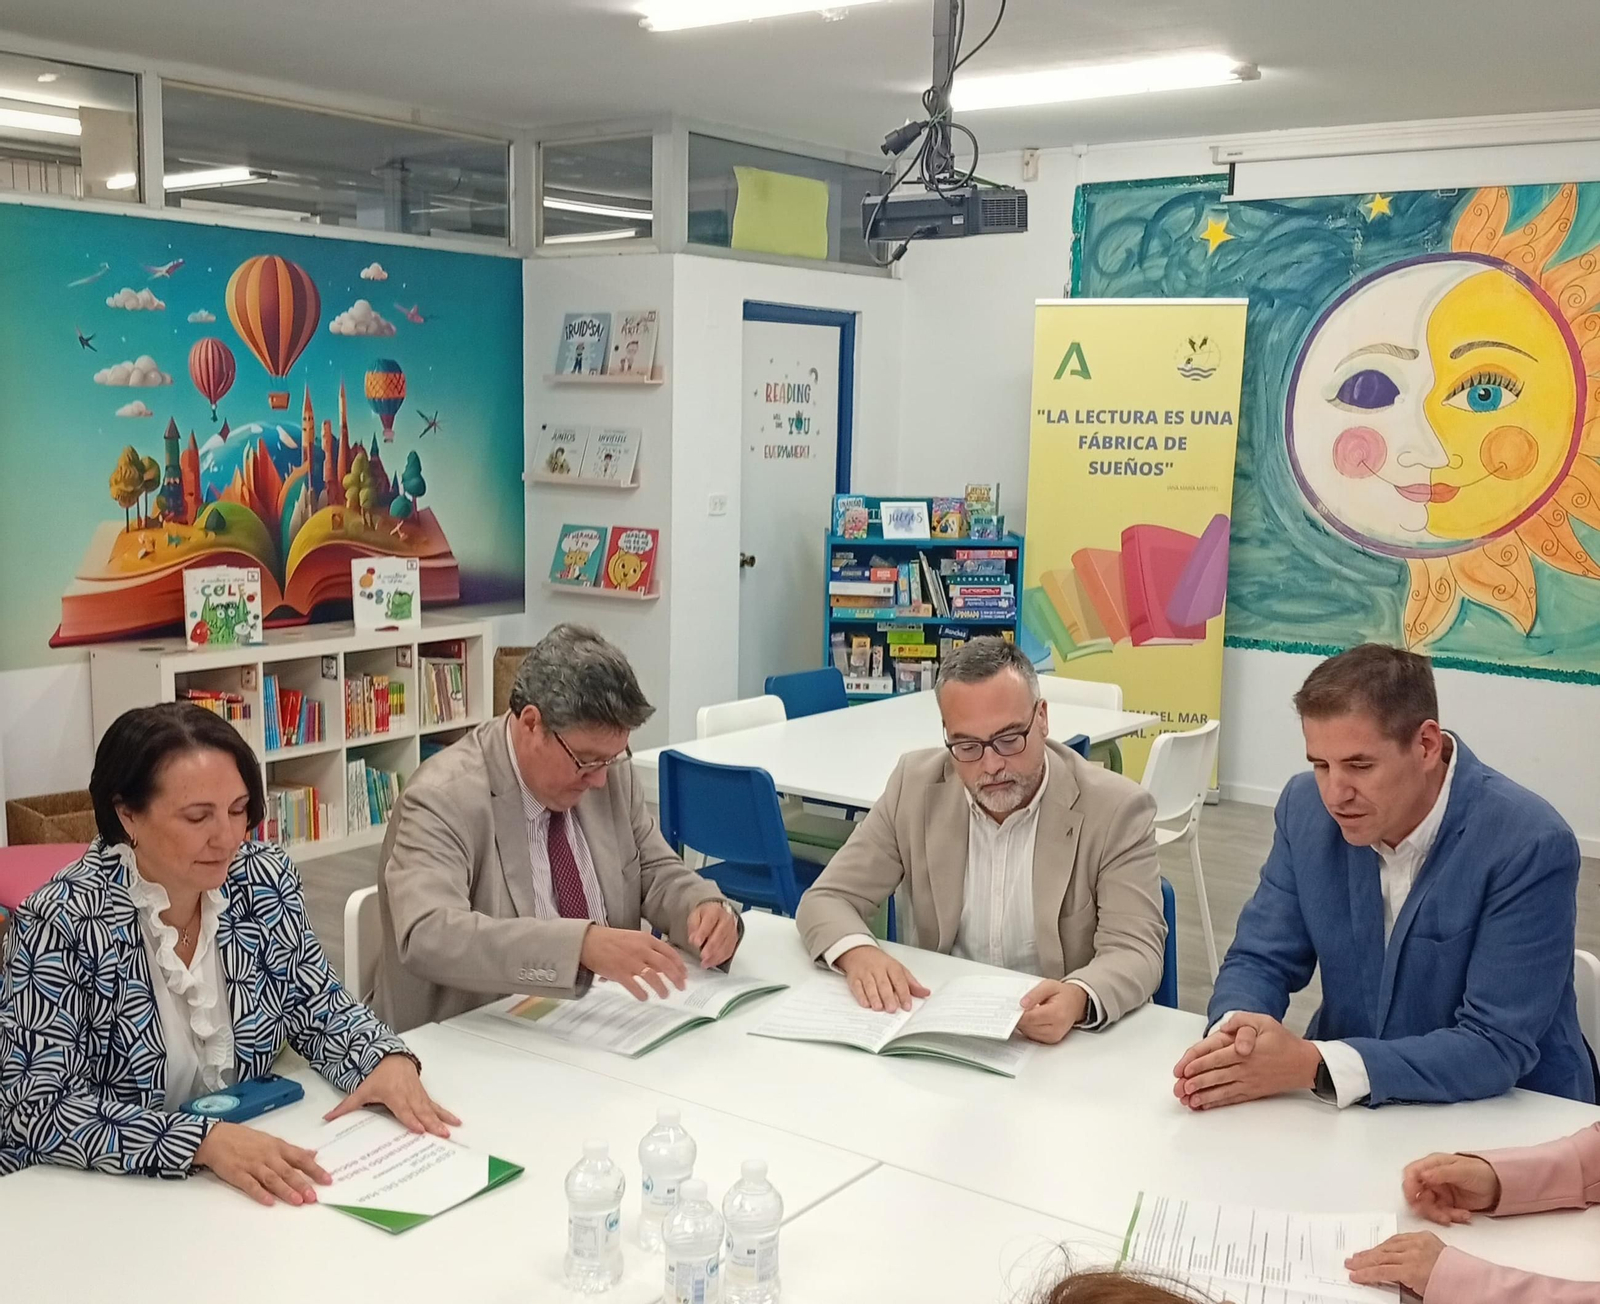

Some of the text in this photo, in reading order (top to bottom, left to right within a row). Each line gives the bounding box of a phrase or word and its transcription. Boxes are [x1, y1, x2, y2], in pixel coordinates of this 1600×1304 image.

[765, 382, 811, 404] READING
[1037, 409, 1233, 425] "LA LECTURA ES UNA
[1078, 432, 1187, 451] FÁBRICA DE
[1088, 458, 1174, 476] SUEÑOS"
[200, 583, 247, 598] COLE
[1178, 712, 1209, 724] MAR
